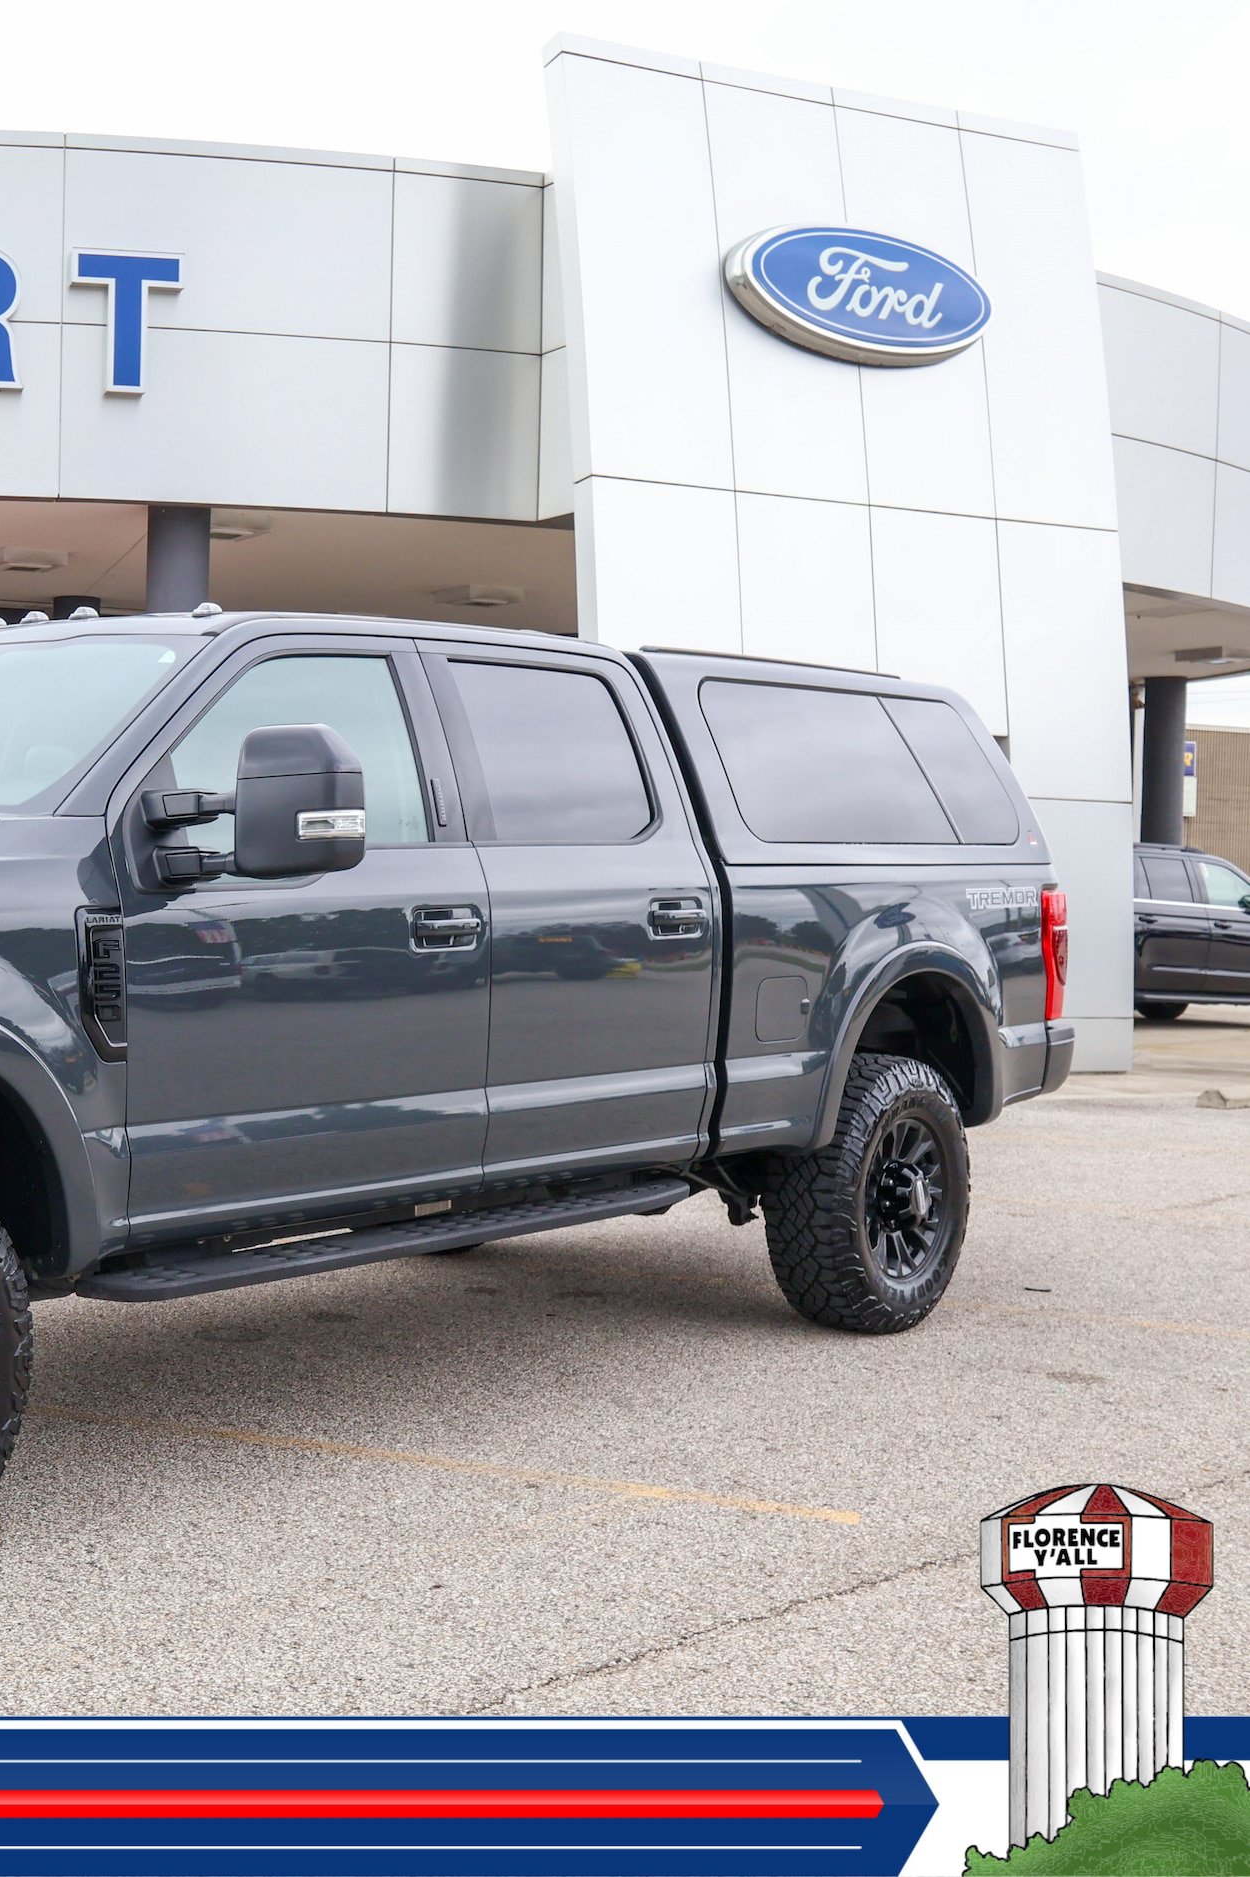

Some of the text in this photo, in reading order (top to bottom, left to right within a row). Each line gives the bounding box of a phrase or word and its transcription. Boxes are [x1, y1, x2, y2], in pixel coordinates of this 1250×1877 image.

[806, 246, 945, 329] Ford
[965, 886, 1038, 910] TREMOR
[86, 914, 121, 924] LARIAT
